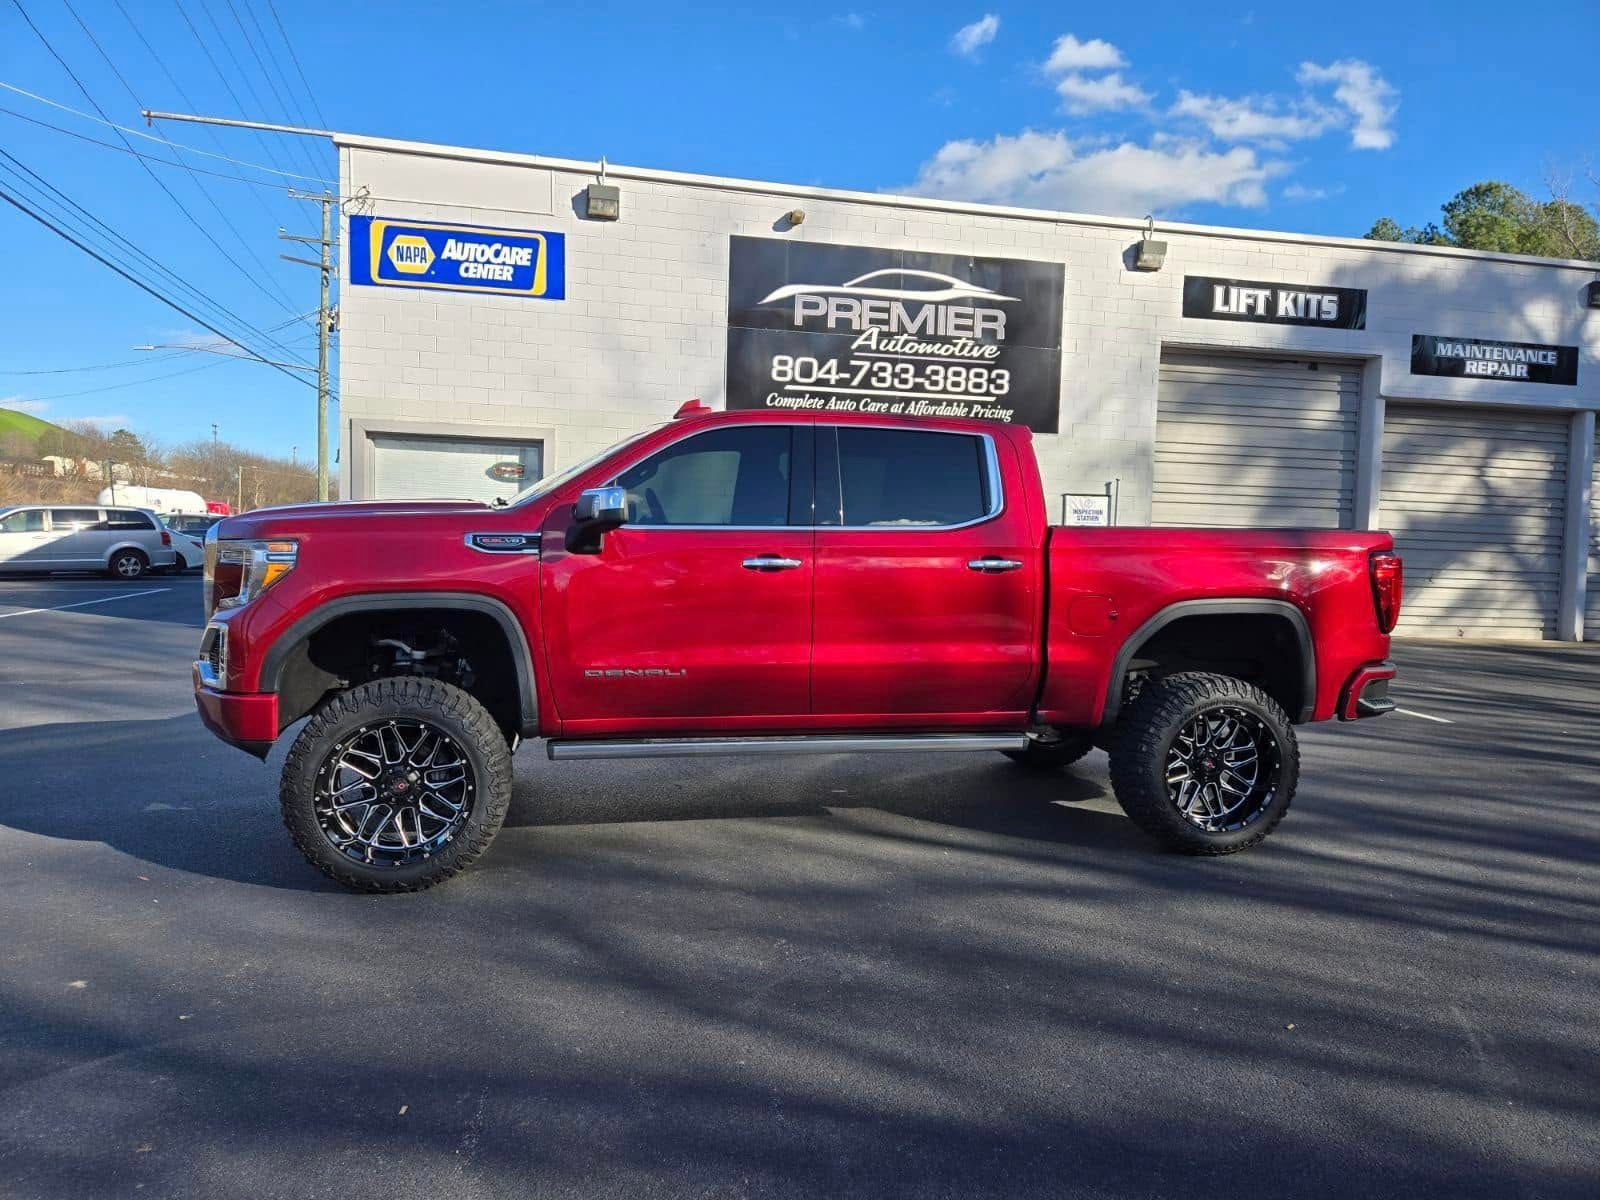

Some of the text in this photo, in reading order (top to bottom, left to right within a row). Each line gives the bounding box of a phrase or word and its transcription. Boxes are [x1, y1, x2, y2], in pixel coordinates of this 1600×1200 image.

[396, 245, 428, 264] NAPA
[459, 263, 513, 281] CENTER
[1212, 284, 1339, 321] LIFT KITS
[794, 294, 1006, 339] PREMIER
[851, 327, 1000, 359] Automotive
[1435, 342, 1558, 365] MAINTENANCE
[770, 355, 1010, 395] 804-733-3883
[1464, 360, 1529, 378] REPAIR
[766, 392, 1014, 423] Complete Auto Care at Affordable Pricing
[584, 668, 687, 678] DENALI
